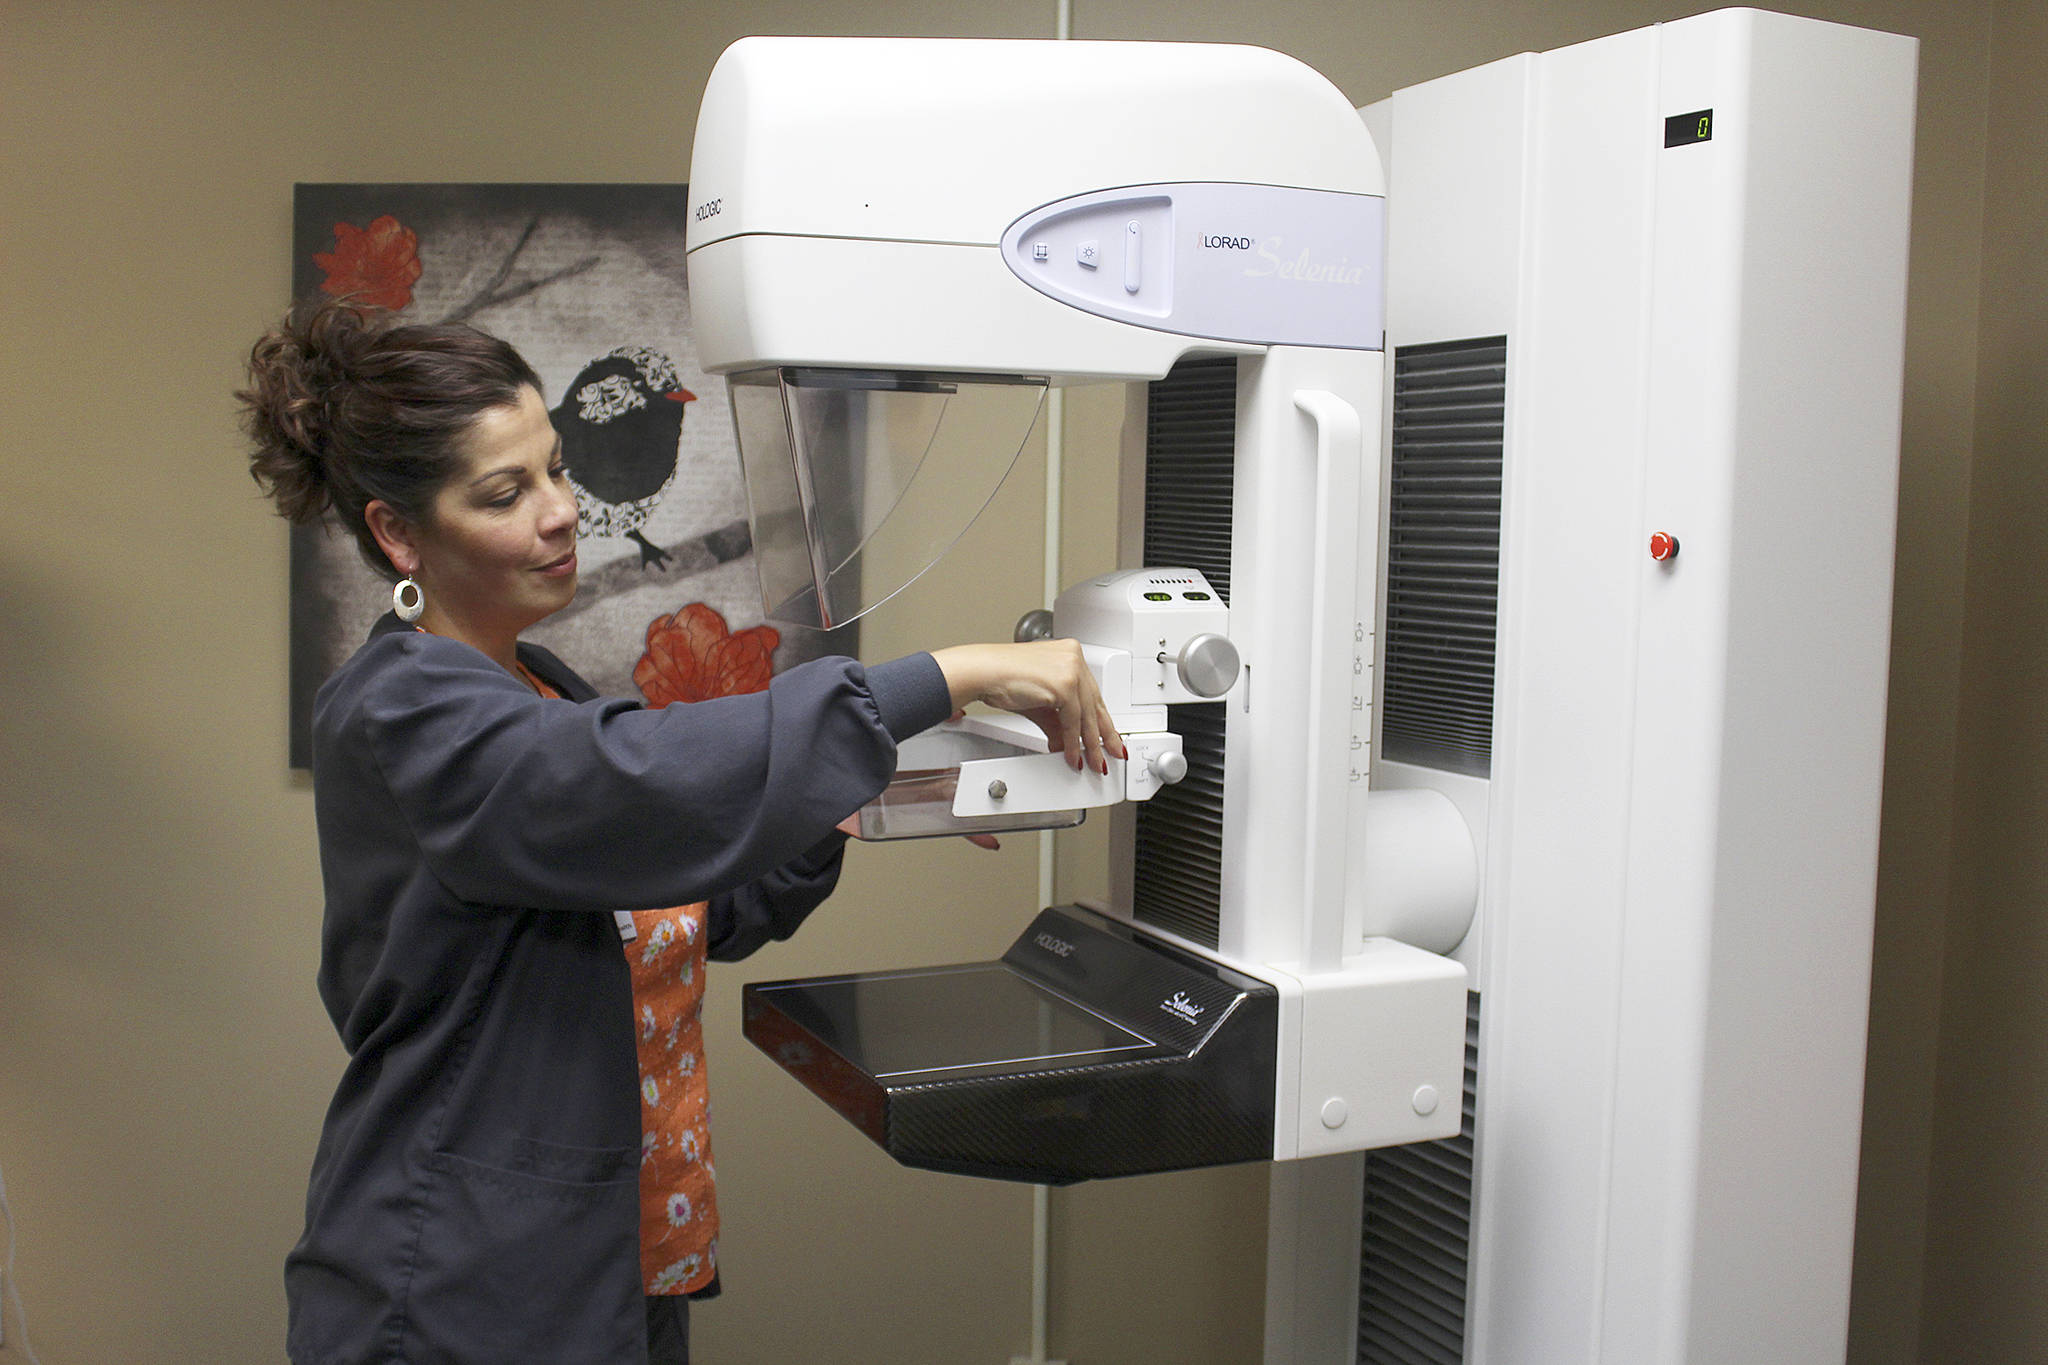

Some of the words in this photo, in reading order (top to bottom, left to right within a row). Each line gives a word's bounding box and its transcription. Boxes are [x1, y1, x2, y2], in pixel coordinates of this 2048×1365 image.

[1697, 116, 1709, 138] 0
[695, 198, 722, 222] HOLOGIC
[1204, 235, 1250, 250] LORAD
[1242, 235, 1362, 284] Selenia
[1034, 932, 1073, 957] HOLOGIC
